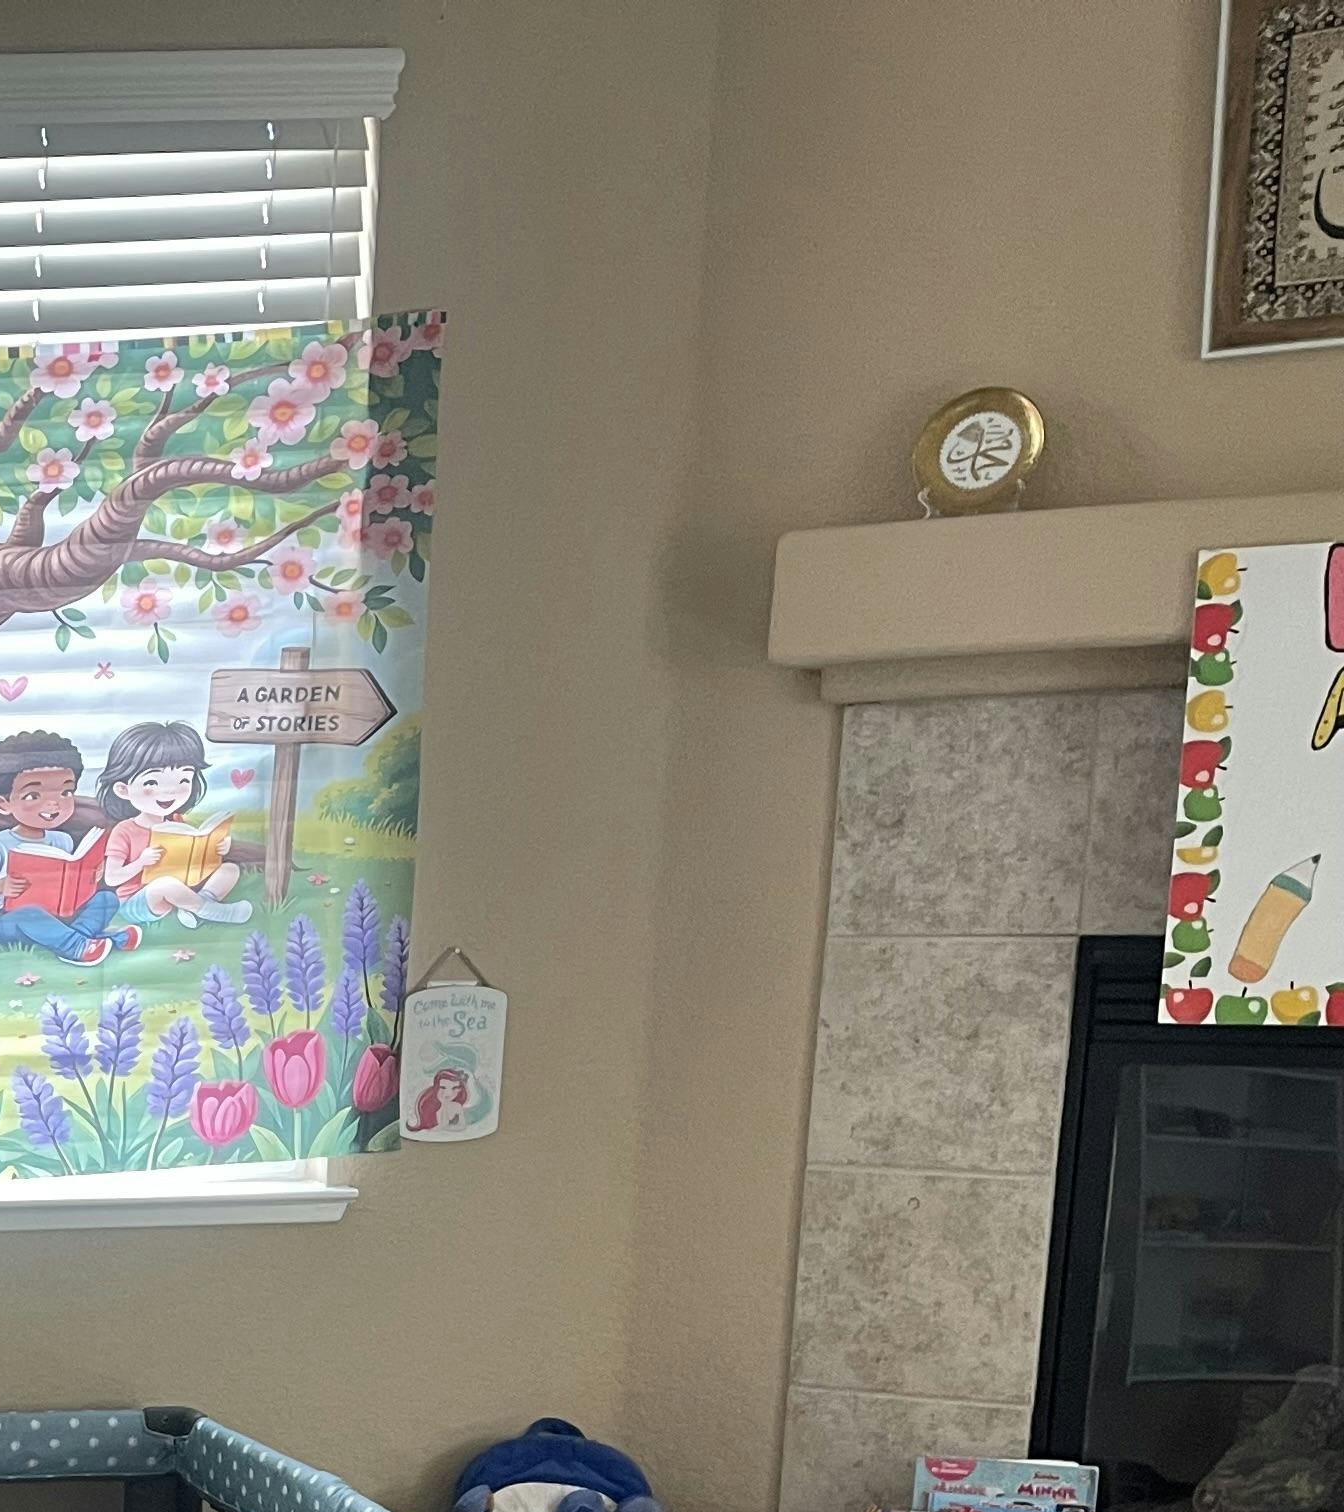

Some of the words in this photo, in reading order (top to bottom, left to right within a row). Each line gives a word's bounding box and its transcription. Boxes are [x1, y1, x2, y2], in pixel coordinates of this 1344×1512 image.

[237, 687, 249, 704] A
[255, 685, 341, 703] GARDEN
[256, 715, 340, 732] STORIES
[449, 1010, 487, 1038] Sea
